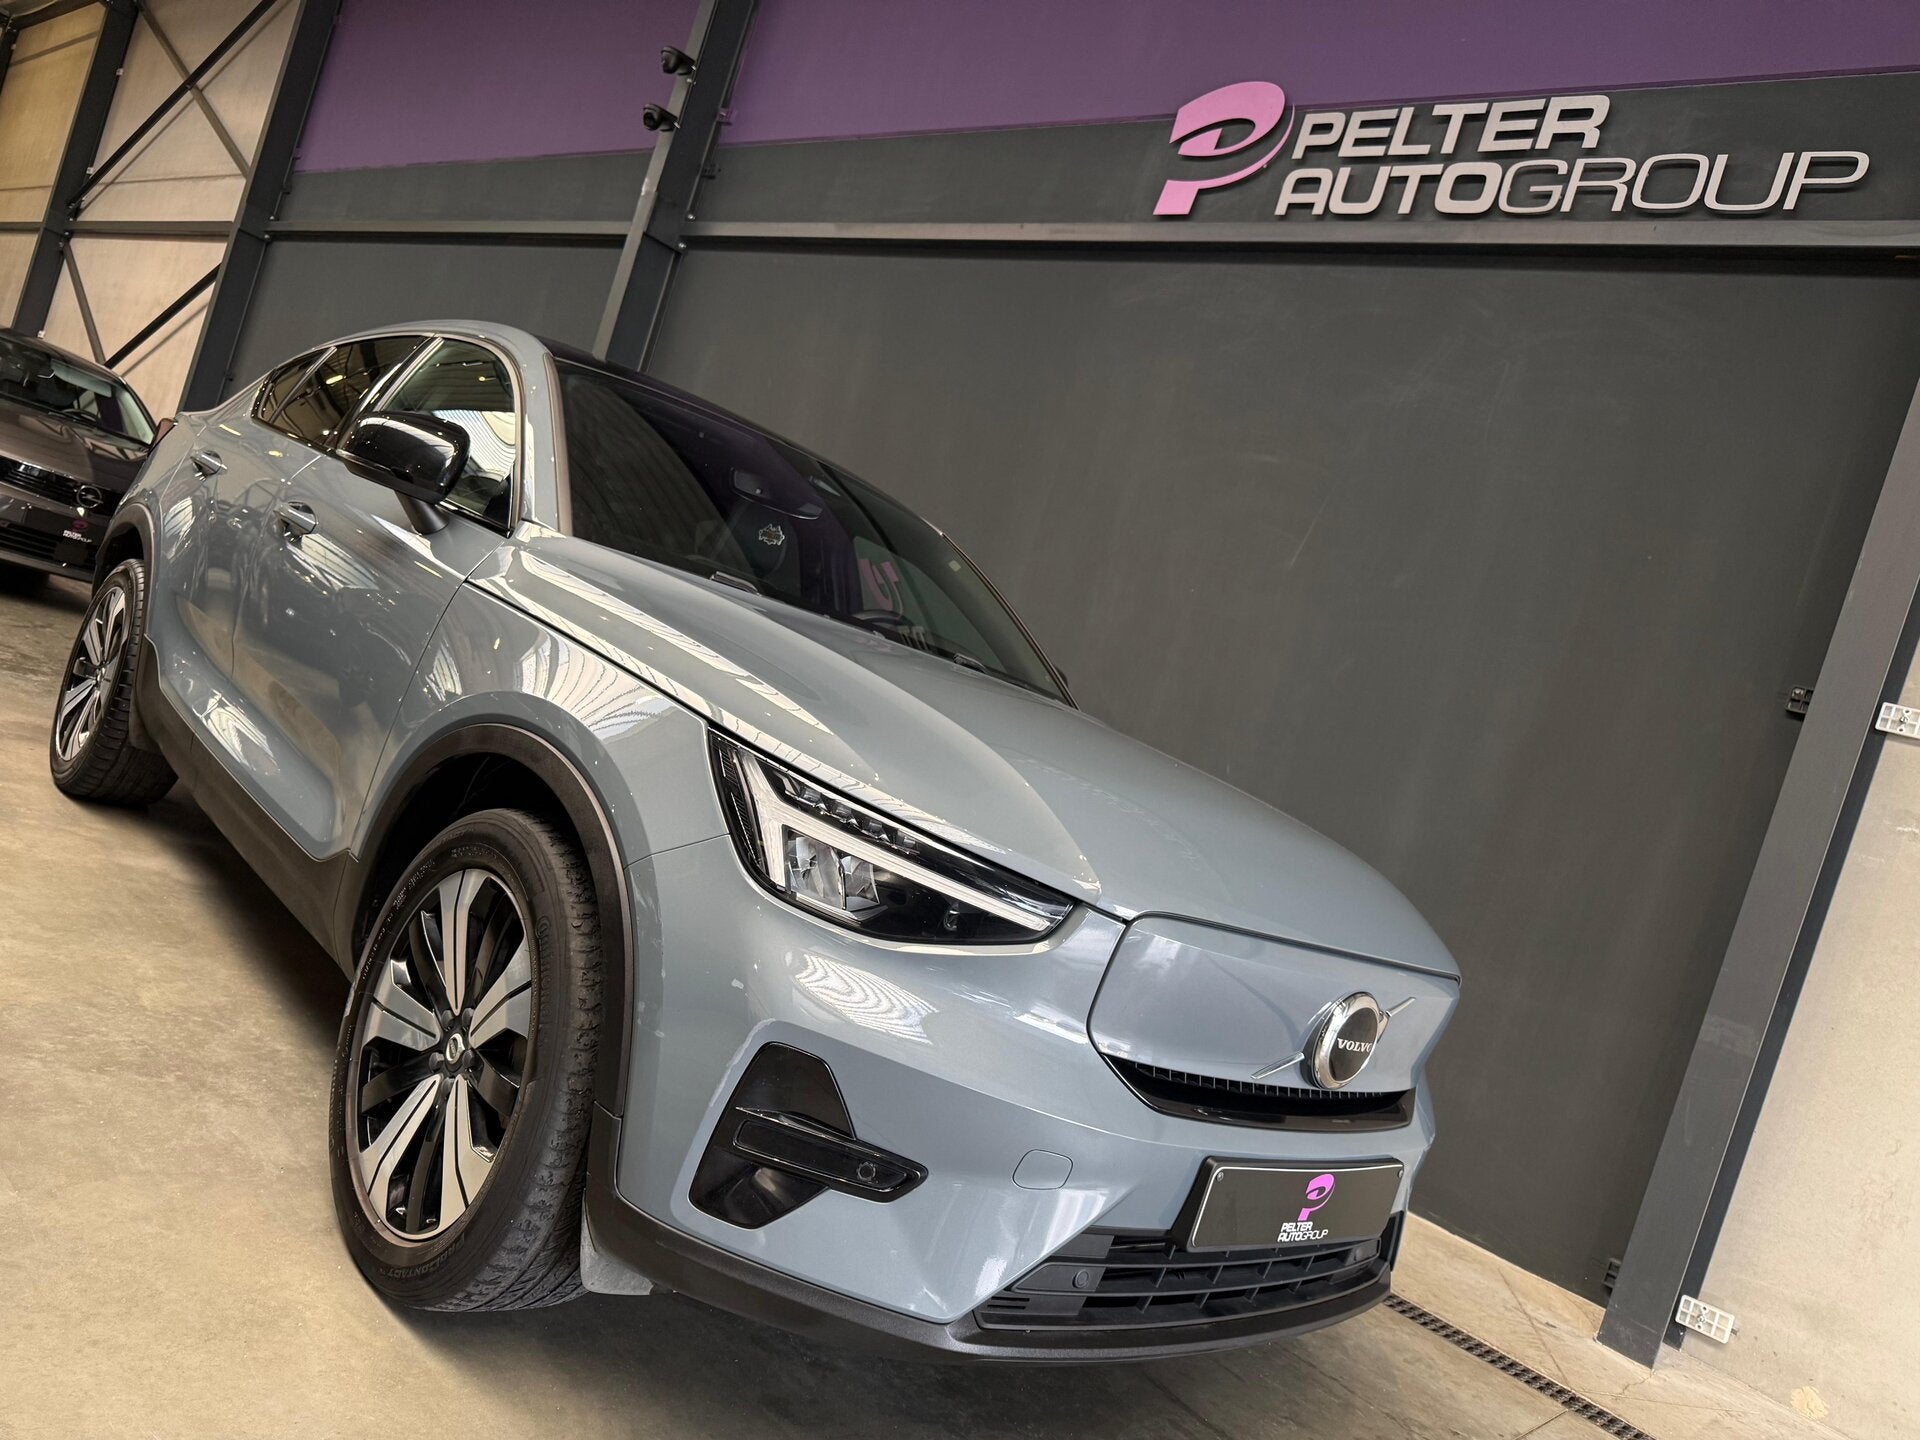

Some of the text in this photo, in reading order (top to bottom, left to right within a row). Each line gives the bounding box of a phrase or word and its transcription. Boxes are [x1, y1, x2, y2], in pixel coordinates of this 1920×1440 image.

[1291, 94, 1610, 160] PELTER
[1274, 150, 1870, 216] AUTOGROUP
[1277, 1229, 1329, 1242] AUTOGROUP
[1280, 1221, 1314, 1233] PELTER
